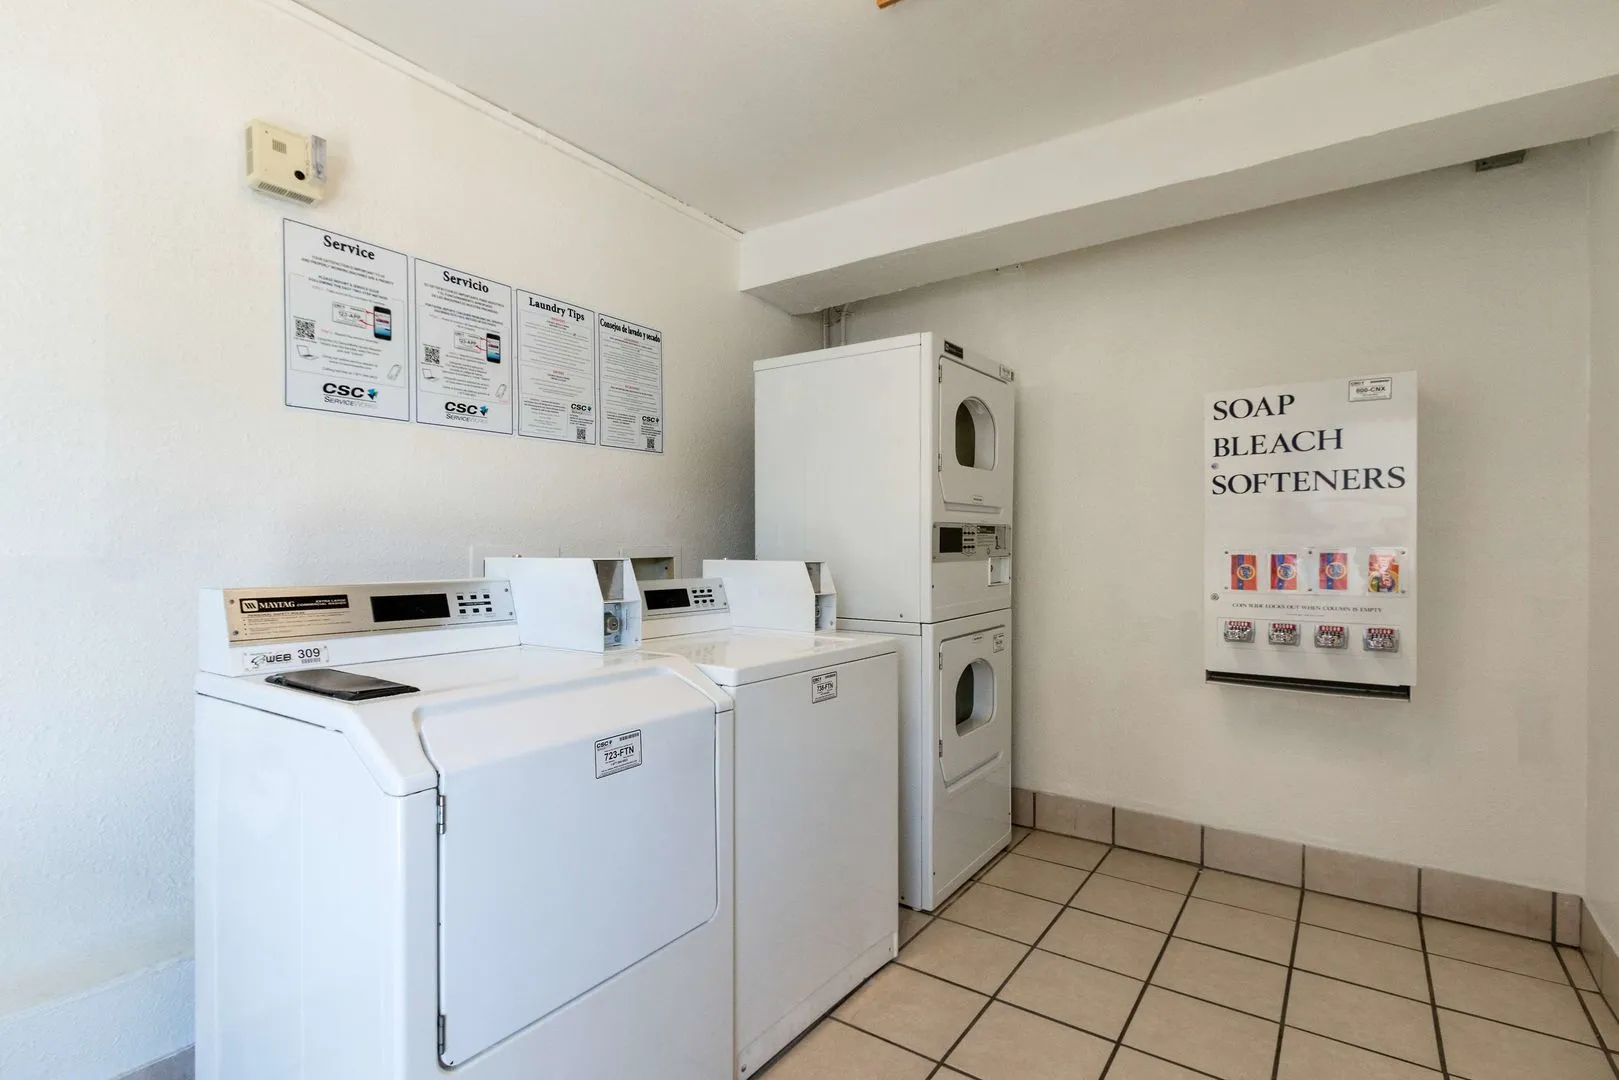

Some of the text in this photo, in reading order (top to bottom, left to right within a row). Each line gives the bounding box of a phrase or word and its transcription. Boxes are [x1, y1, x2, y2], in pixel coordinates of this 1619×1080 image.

[323, 234, 375, 260] Service
[443, 270, 489, 293] Servicio
[528, 296, 585, 322] Laundry Tips
[599, 318, 621, 332] Consejos
[621, 324, 628, 333] de
[627, 326, 643, 338] lavado
[646, 333, 661, 343] secado
[322, 382, 365, 398] CSC
[444, 401, 478, 415] CSC
[570, 403, 587, 411] CSC
[1213, 394, 1295, 421] SOAP
[642, 415, 655, 423] CSC
[1213, 428, 1344, 458] BLEACH
[1212, 466, 1406, 496] SOFTENERS
[258, 600, 296, 610] MAYTAG
[266, 648, 320, 663] WEB 309
[604, 745, 634, 761] 723-FTN
